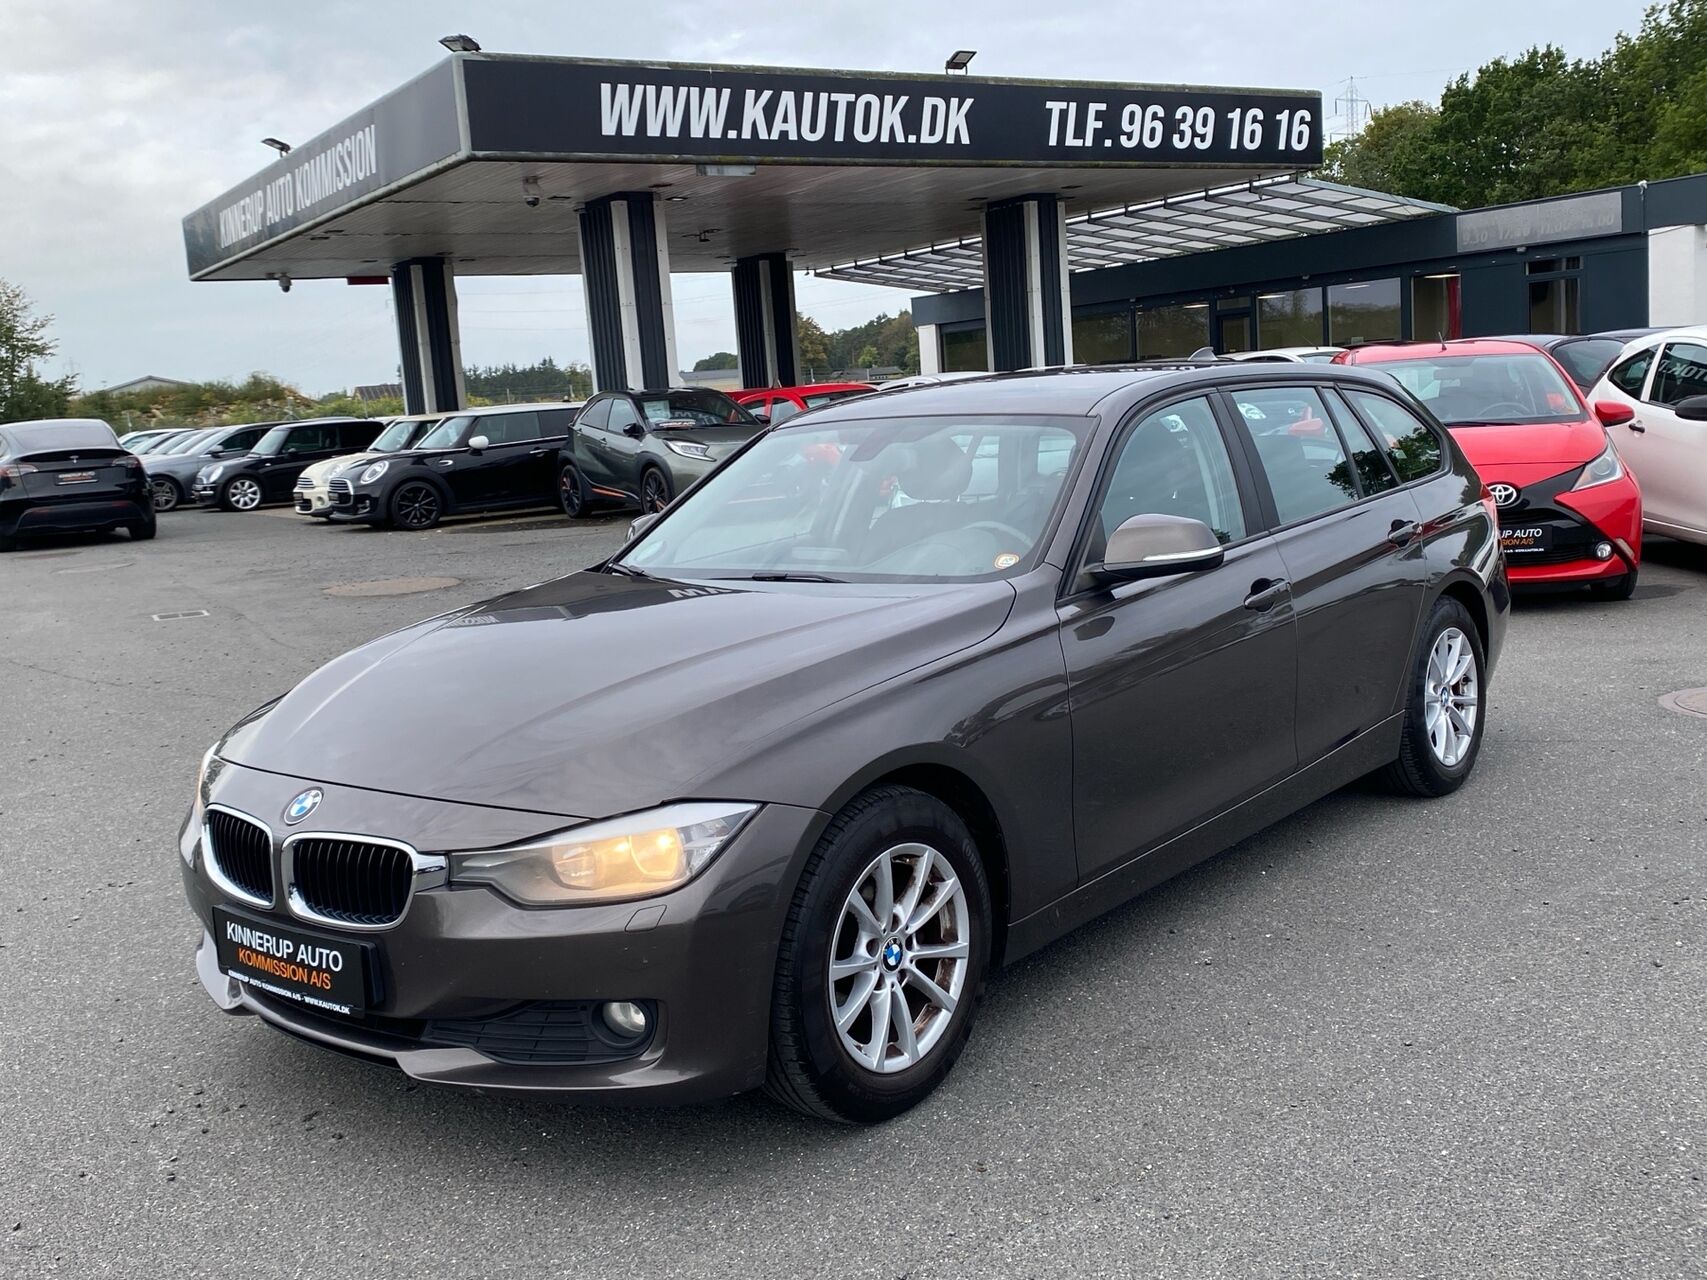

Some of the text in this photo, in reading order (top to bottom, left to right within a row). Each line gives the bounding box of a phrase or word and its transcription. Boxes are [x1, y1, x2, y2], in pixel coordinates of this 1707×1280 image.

[601, 82, 974, 145] WWW.KAUTOK.DK
[1045, 100, 1312, 151] TLF. 96 39 16 16
[219, 124, 377, 249] KINNERUP AUTO KOMMISSION
[1513, 528, 1543, 538] AUTO
[226, 921, 343, 972] KINNERUP AUTO
[238, 948, 331, 989] KOMMISSION A/S
